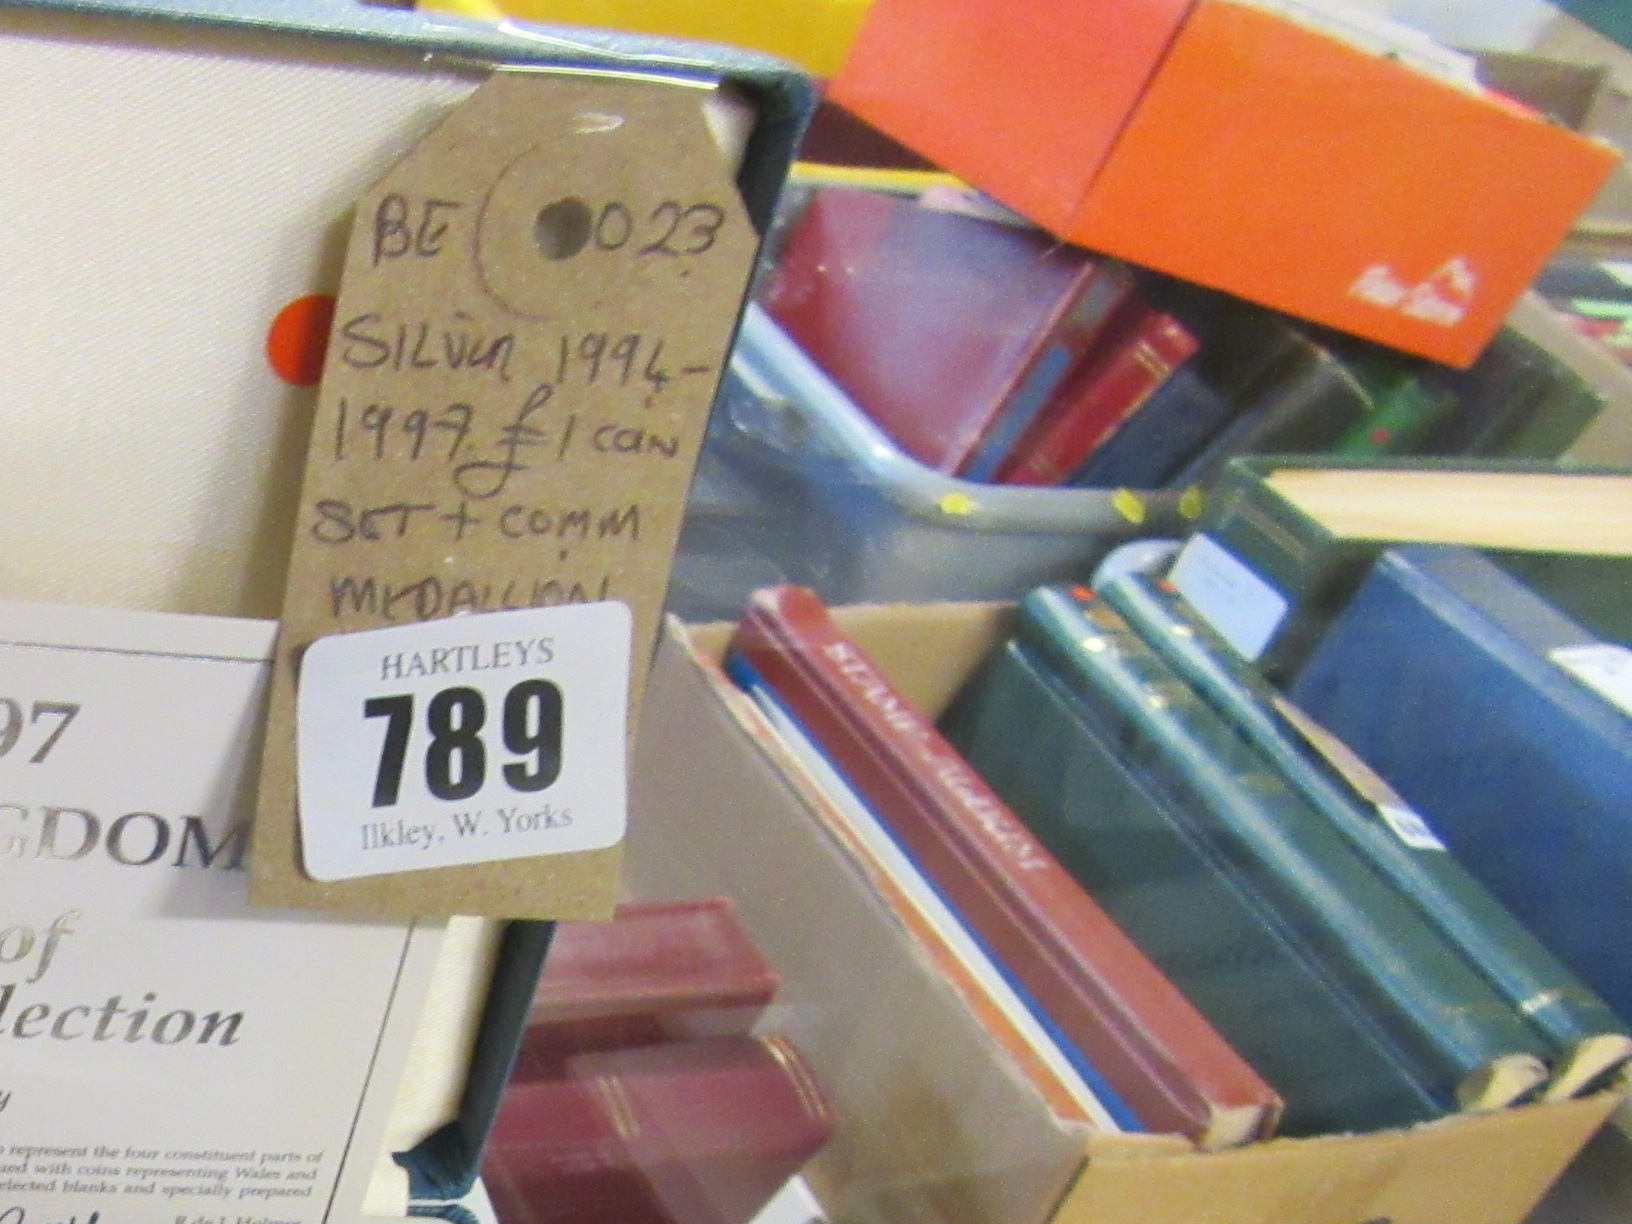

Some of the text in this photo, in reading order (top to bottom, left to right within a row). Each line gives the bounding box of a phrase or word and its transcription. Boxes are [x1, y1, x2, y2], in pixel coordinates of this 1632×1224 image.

[335, 397, 475, 461] 1997
[380, 637, 555, 681] HARTLEYS
[363, 678, 564, 808] 789
[451, 812, 490, 838] W.
[497, 804, 574, 835] Yorks
